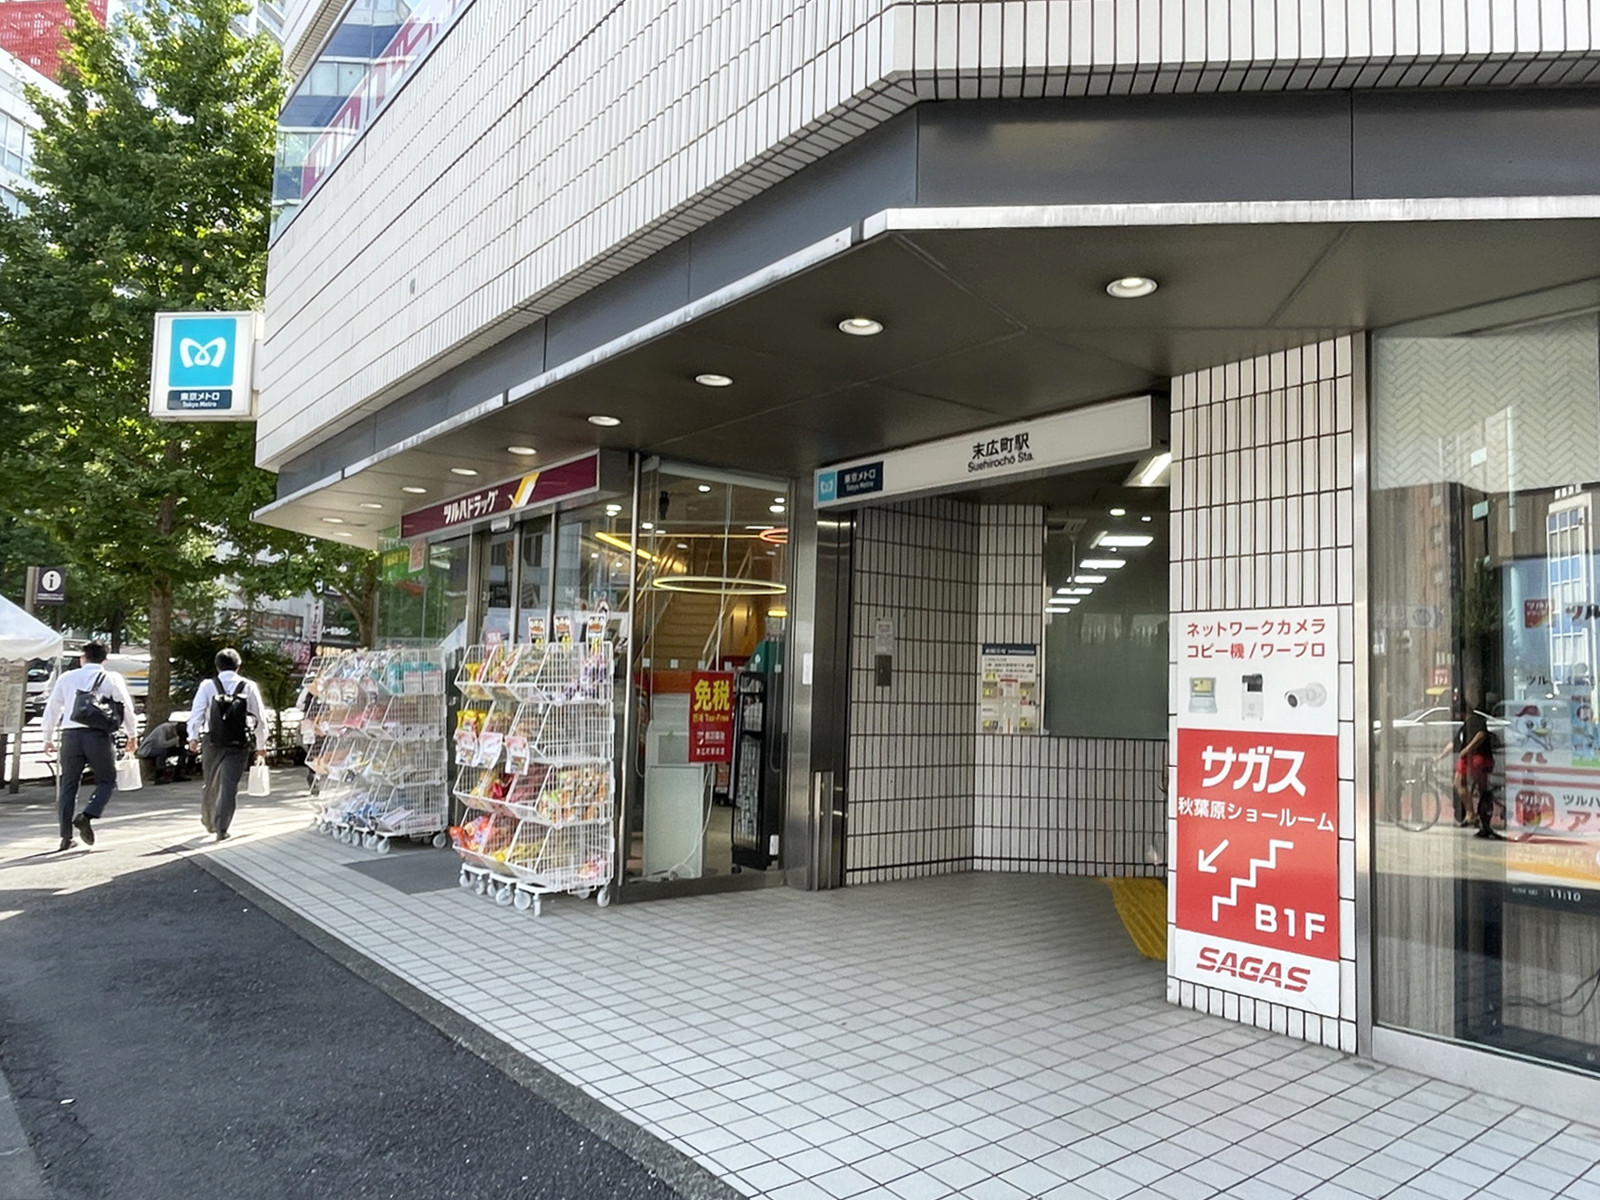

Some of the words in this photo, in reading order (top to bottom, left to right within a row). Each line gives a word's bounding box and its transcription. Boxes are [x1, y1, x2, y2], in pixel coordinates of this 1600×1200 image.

[972, 432, 1030, 460] 末広町駅
[1017, 451, 1035, 463] Sta.
[443, 489, 499, 525] ツルハドラッグ
[1186, 618, 1326, 638] ネットワークカメラ
[694, 679, 730, 711] 免税
[1201, 745, 1307, 797] サガス
[1178, 797, 1335, 832] 秋葉原ショールーム
[1255, 903, 1326, 941] B1F
[1196, 946, 1311, 993] SAGAS
